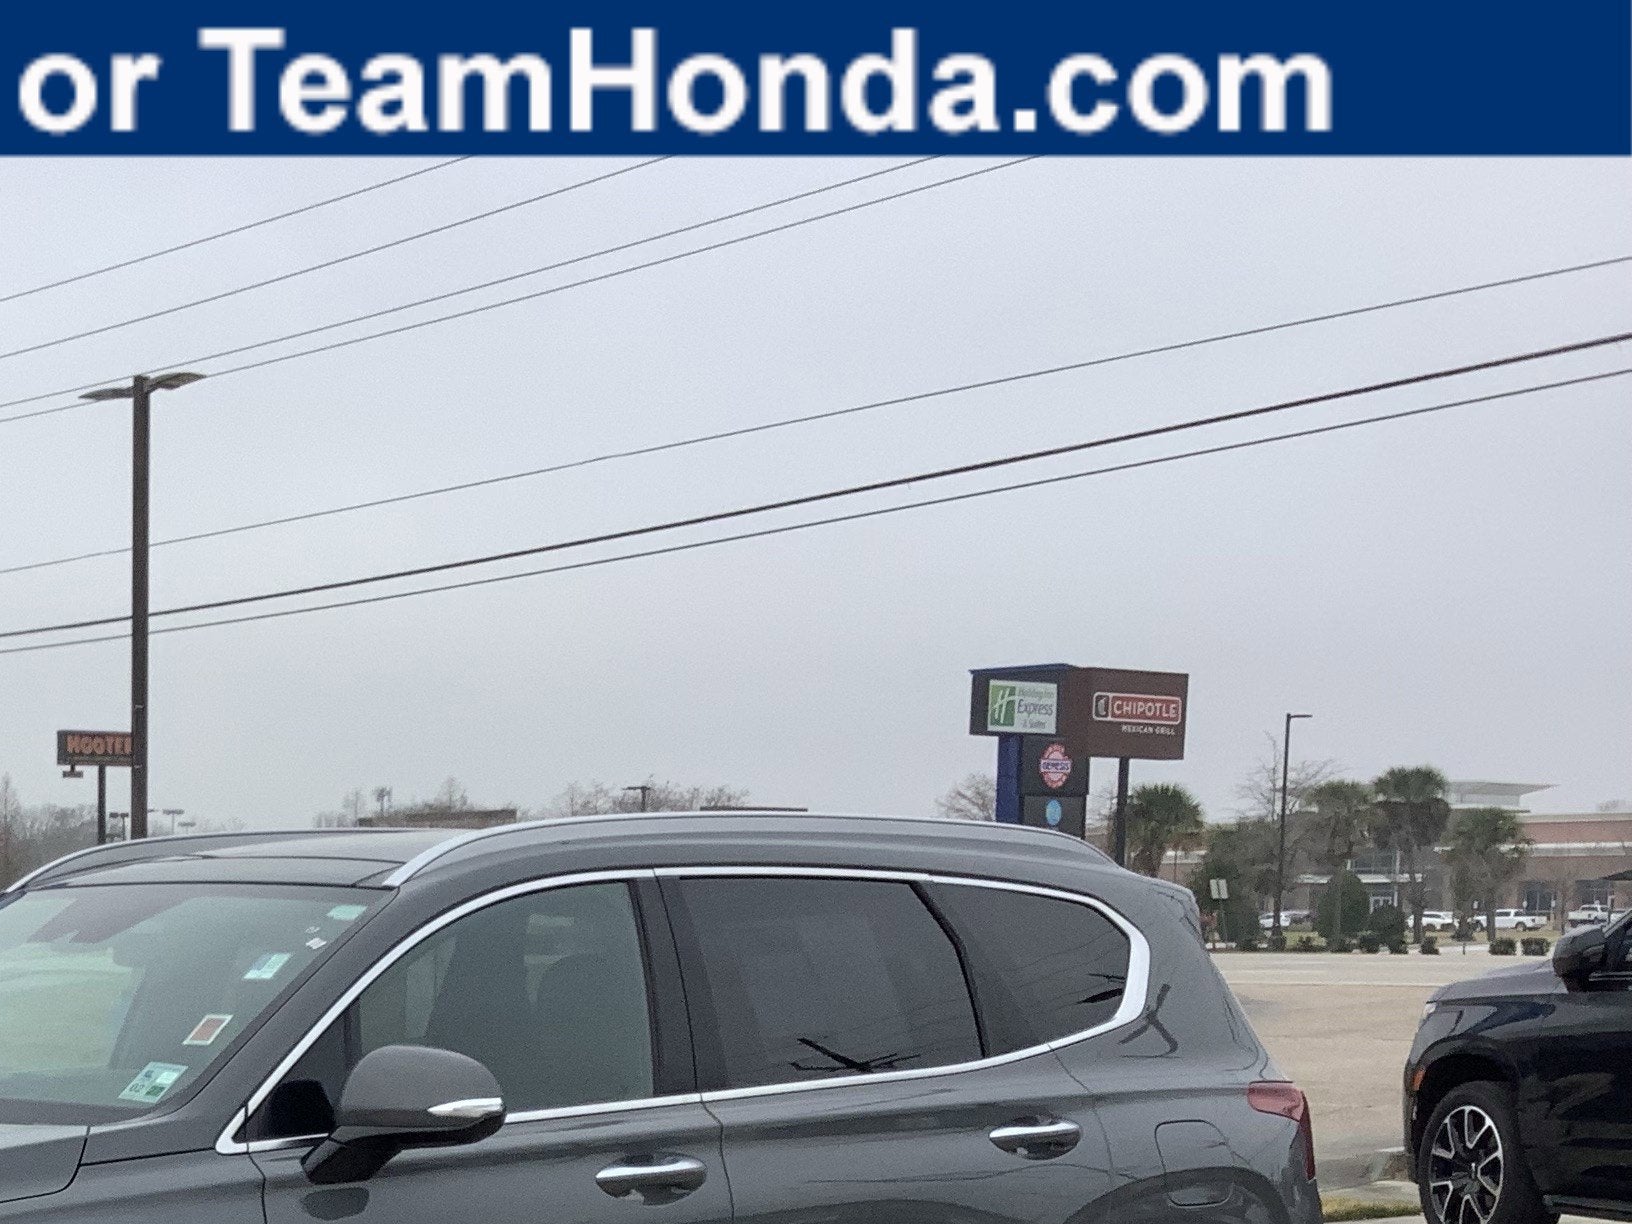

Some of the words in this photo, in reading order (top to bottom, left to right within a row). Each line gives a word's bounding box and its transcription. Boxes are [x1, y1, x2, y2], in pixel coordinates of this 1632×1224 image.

[1018, 699, 1054, 717] Express
[1113, 701, 1177, 719] CHIPOTLE
[1121, 725, 1154, 734] MEXICAN
[66, 735, 132, 755] HOOTE
